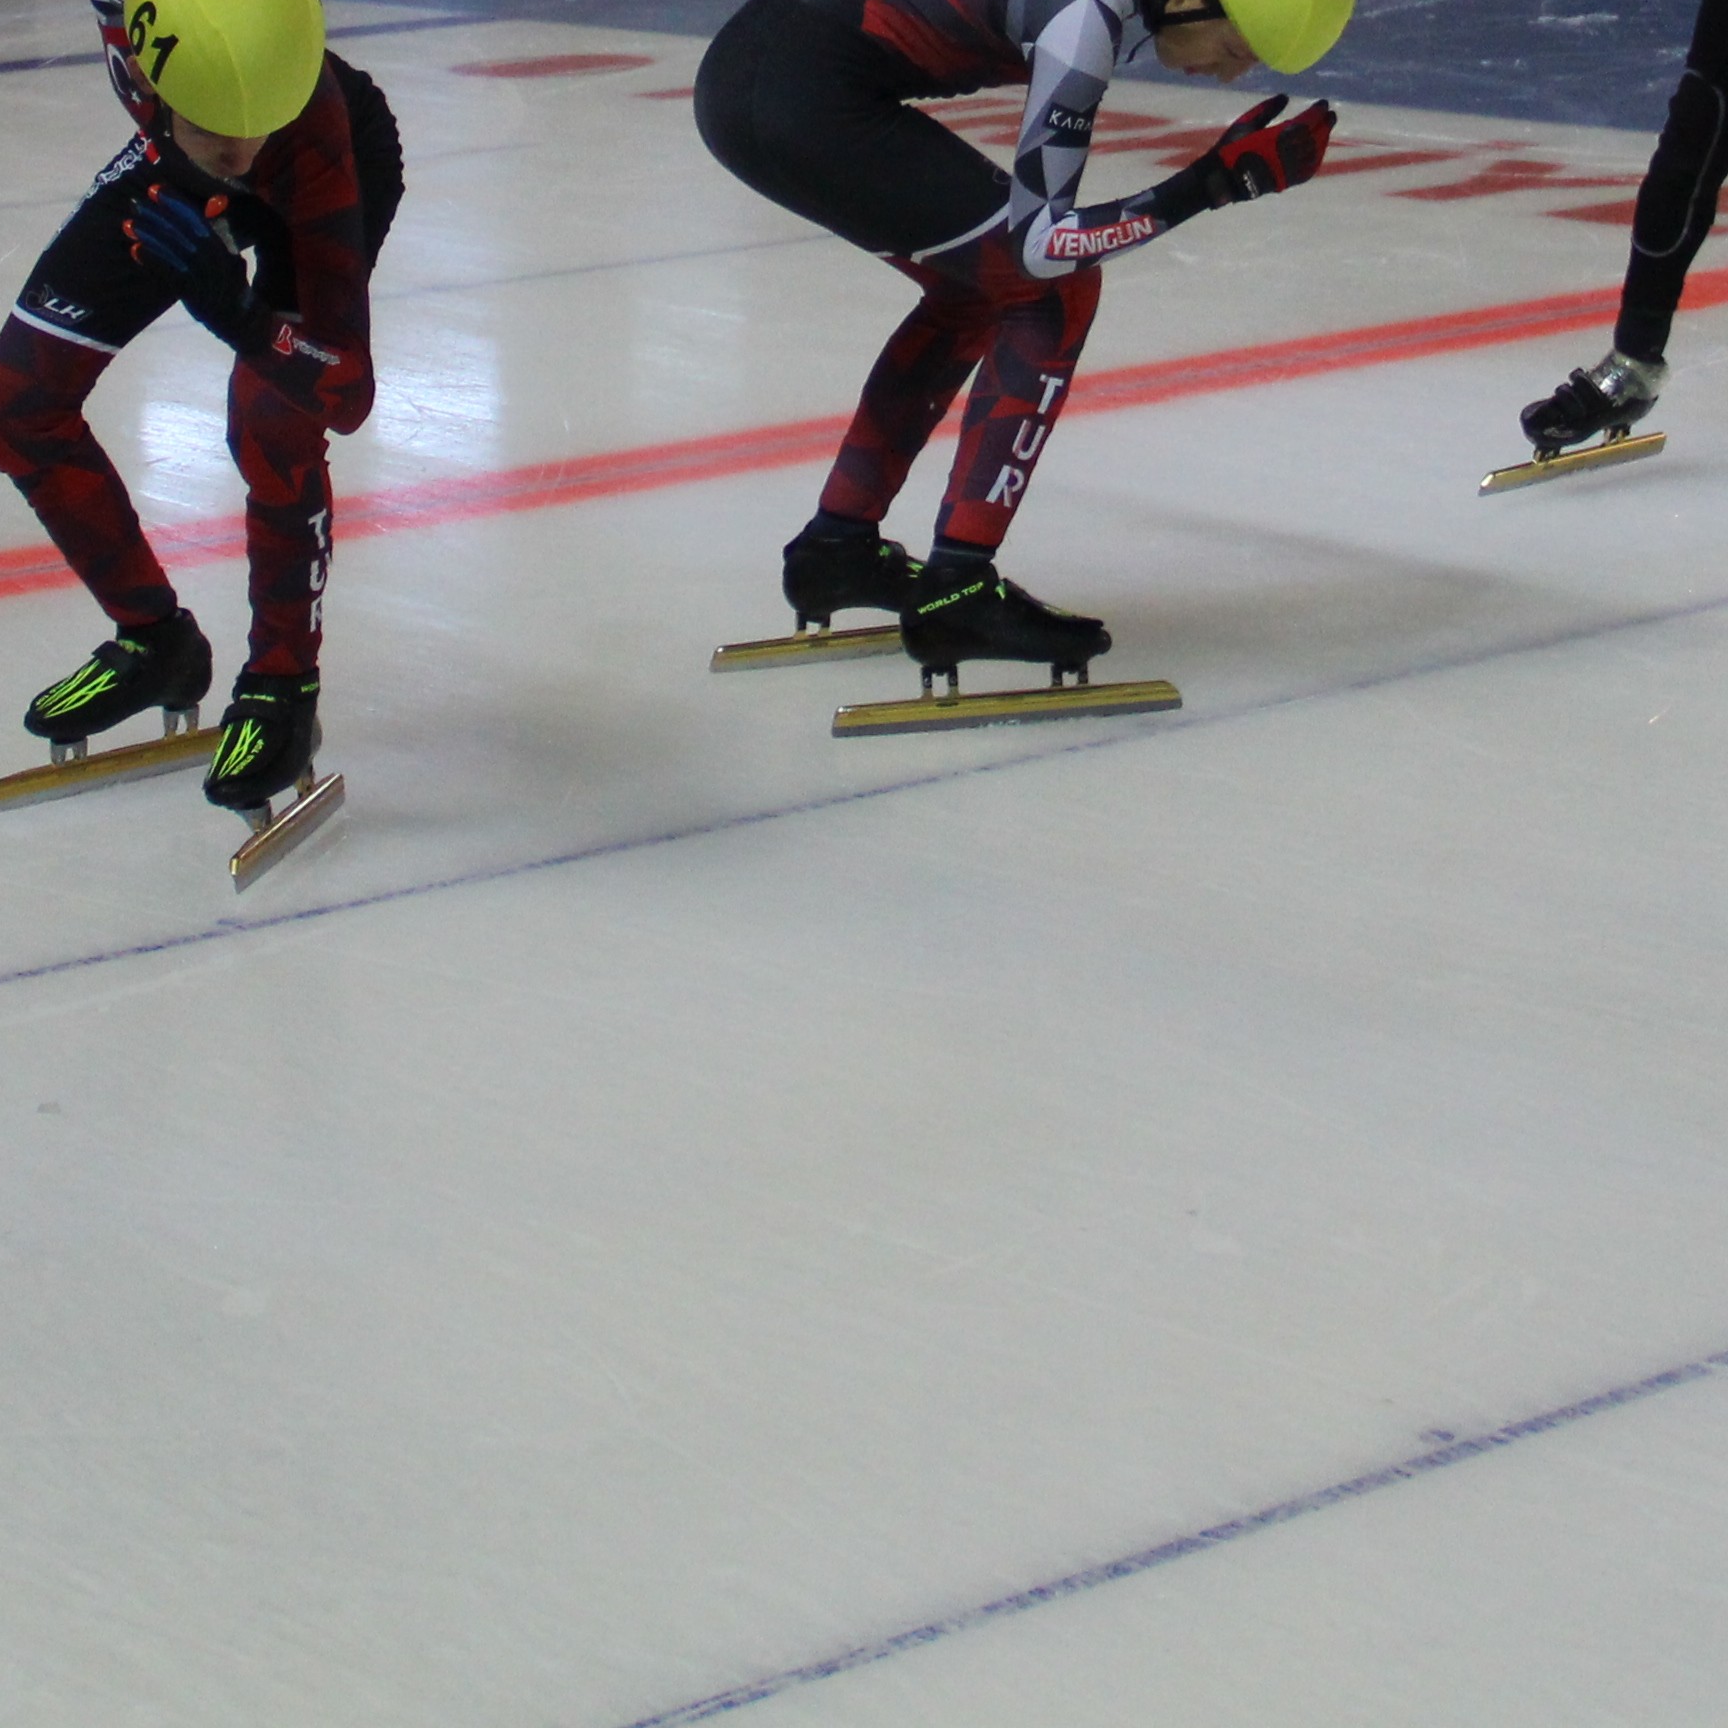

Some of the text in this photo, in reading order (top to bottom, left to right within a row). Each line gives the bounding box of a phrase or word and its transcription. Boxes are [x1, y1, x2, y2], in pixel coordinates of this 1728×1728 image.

[129, 0, 179, 85] 61
[984, 372, 1066, 509] TUR
[917, 580, 986, 615] WORLD TOP
